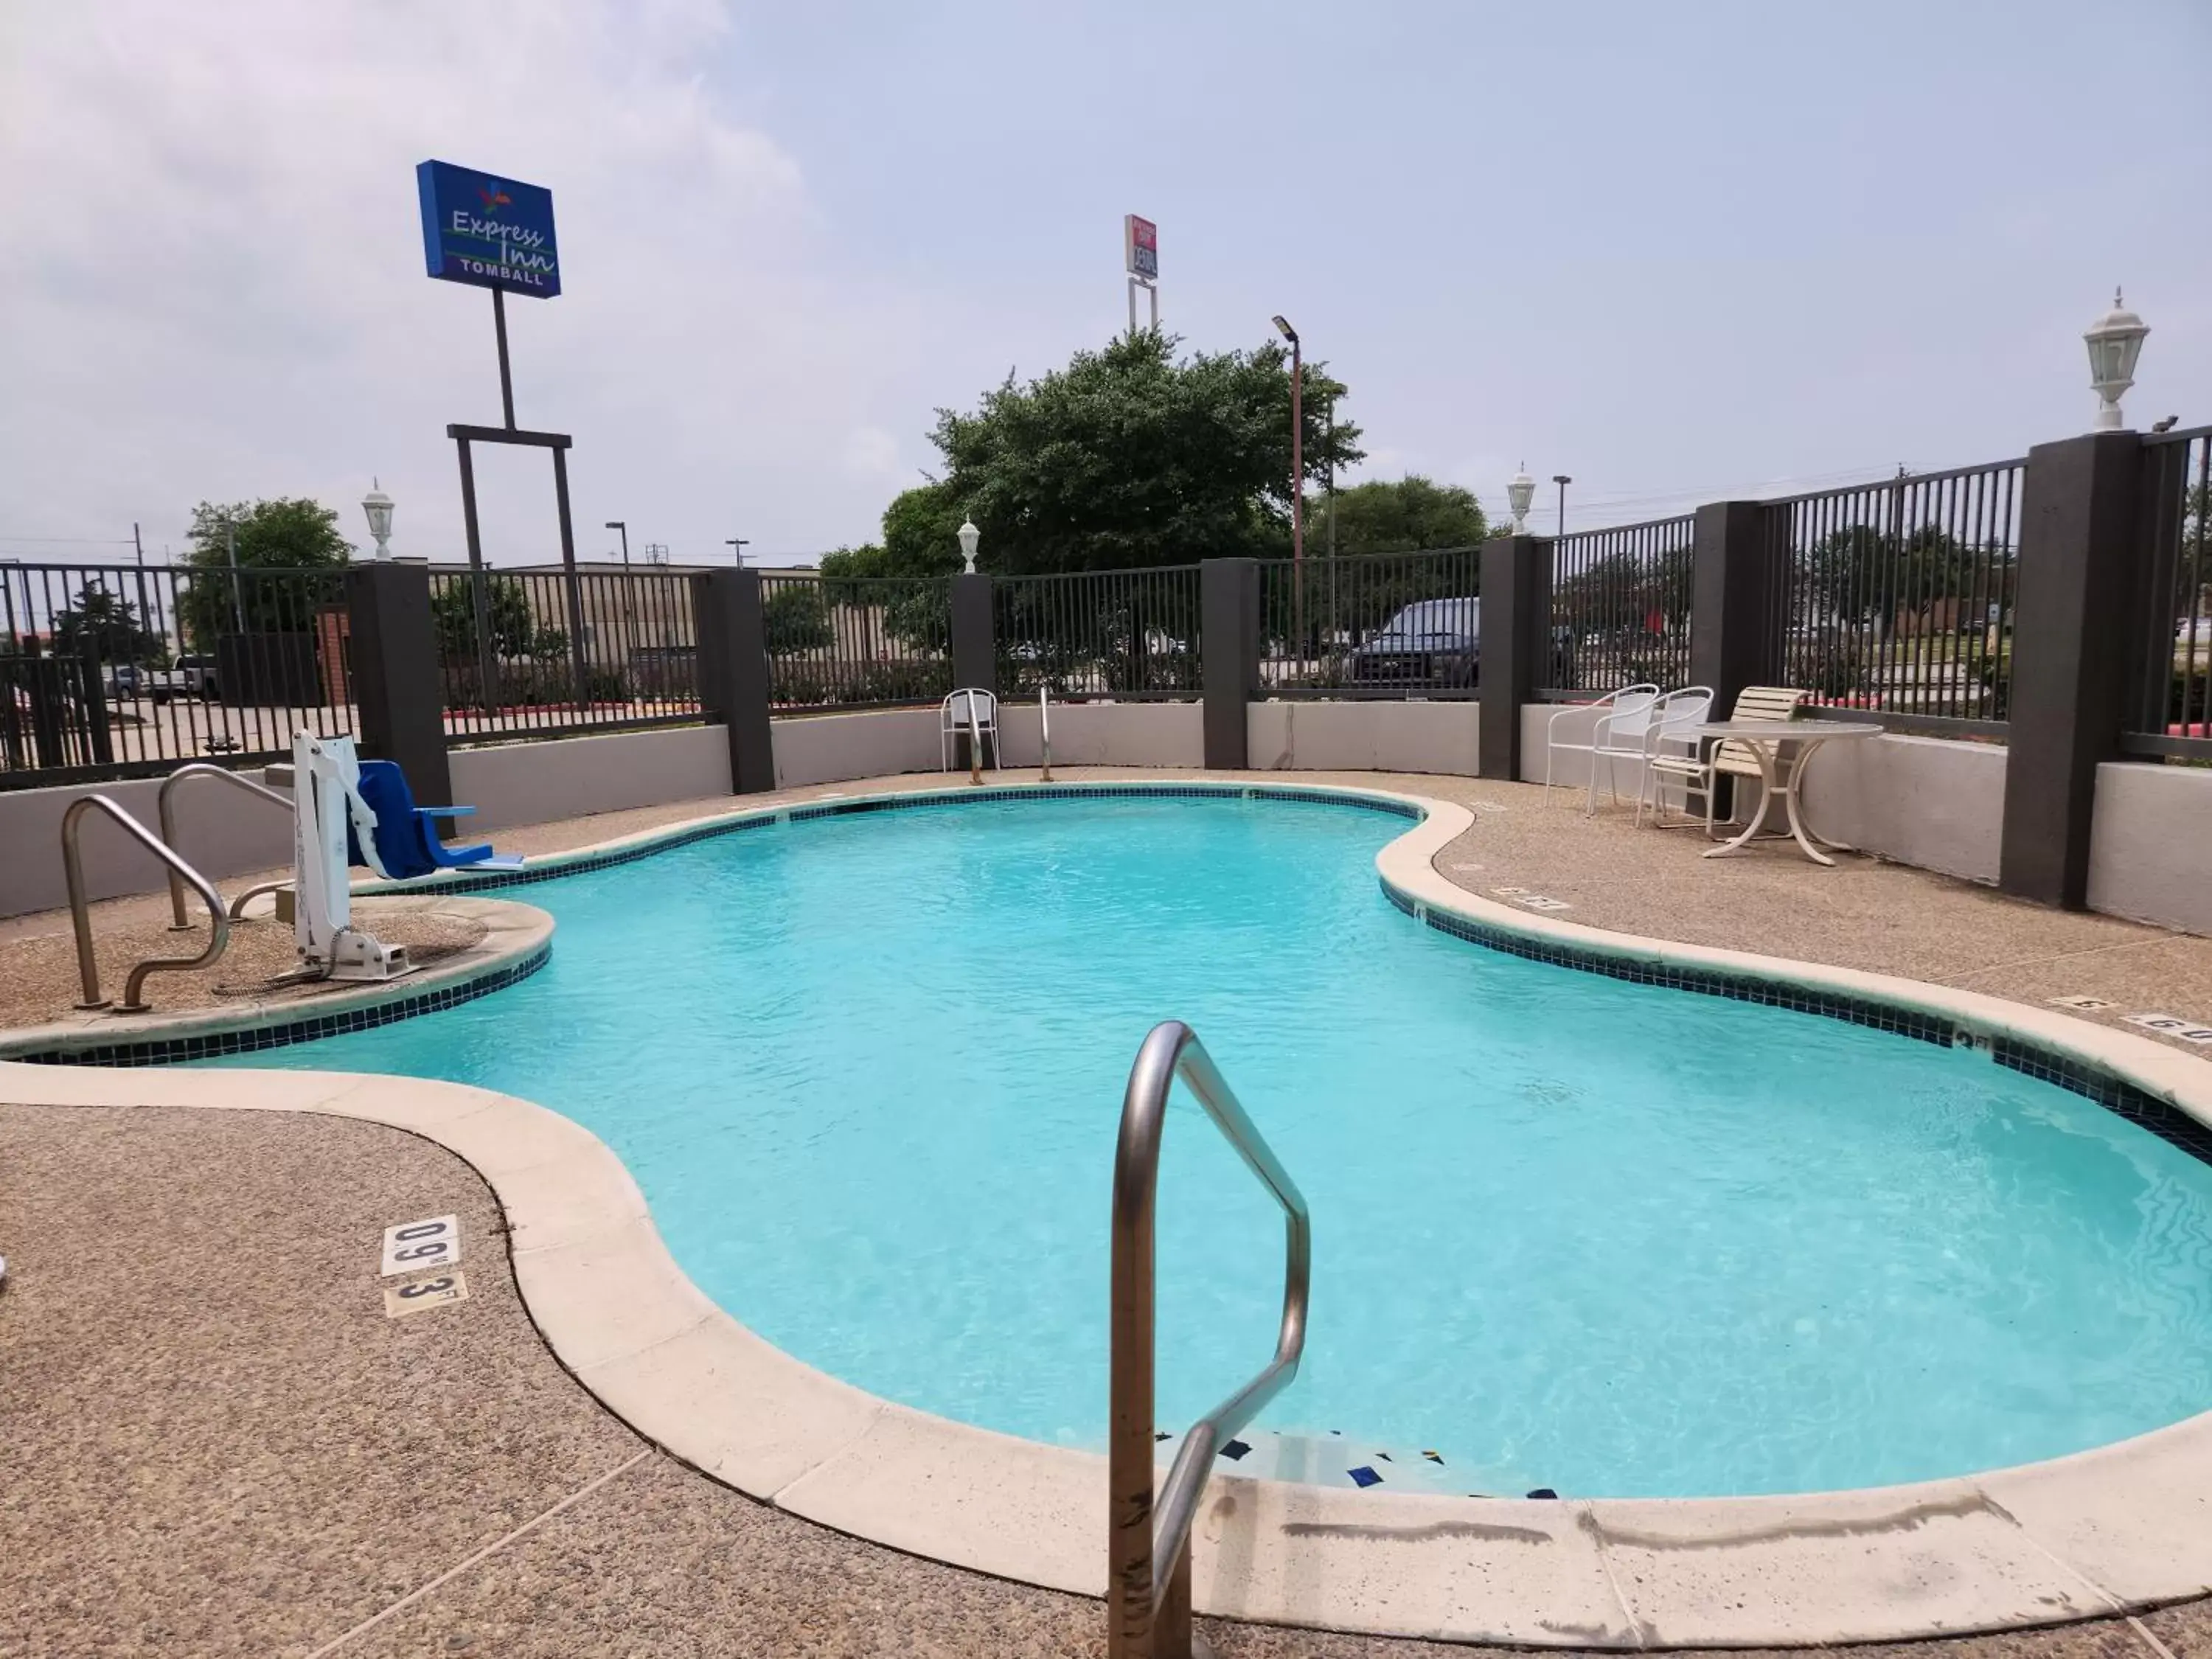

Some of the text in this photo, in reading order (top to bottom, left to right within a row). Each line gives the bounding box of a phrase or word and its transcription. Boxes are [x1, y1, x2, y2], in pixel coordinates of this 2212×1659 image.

[453, 210, 544, 248] Express
[501, 239, 554, 271] Inn
[460, 259, 543, 285] TOMBALL
[399, 1278, 454, 1298] 3
